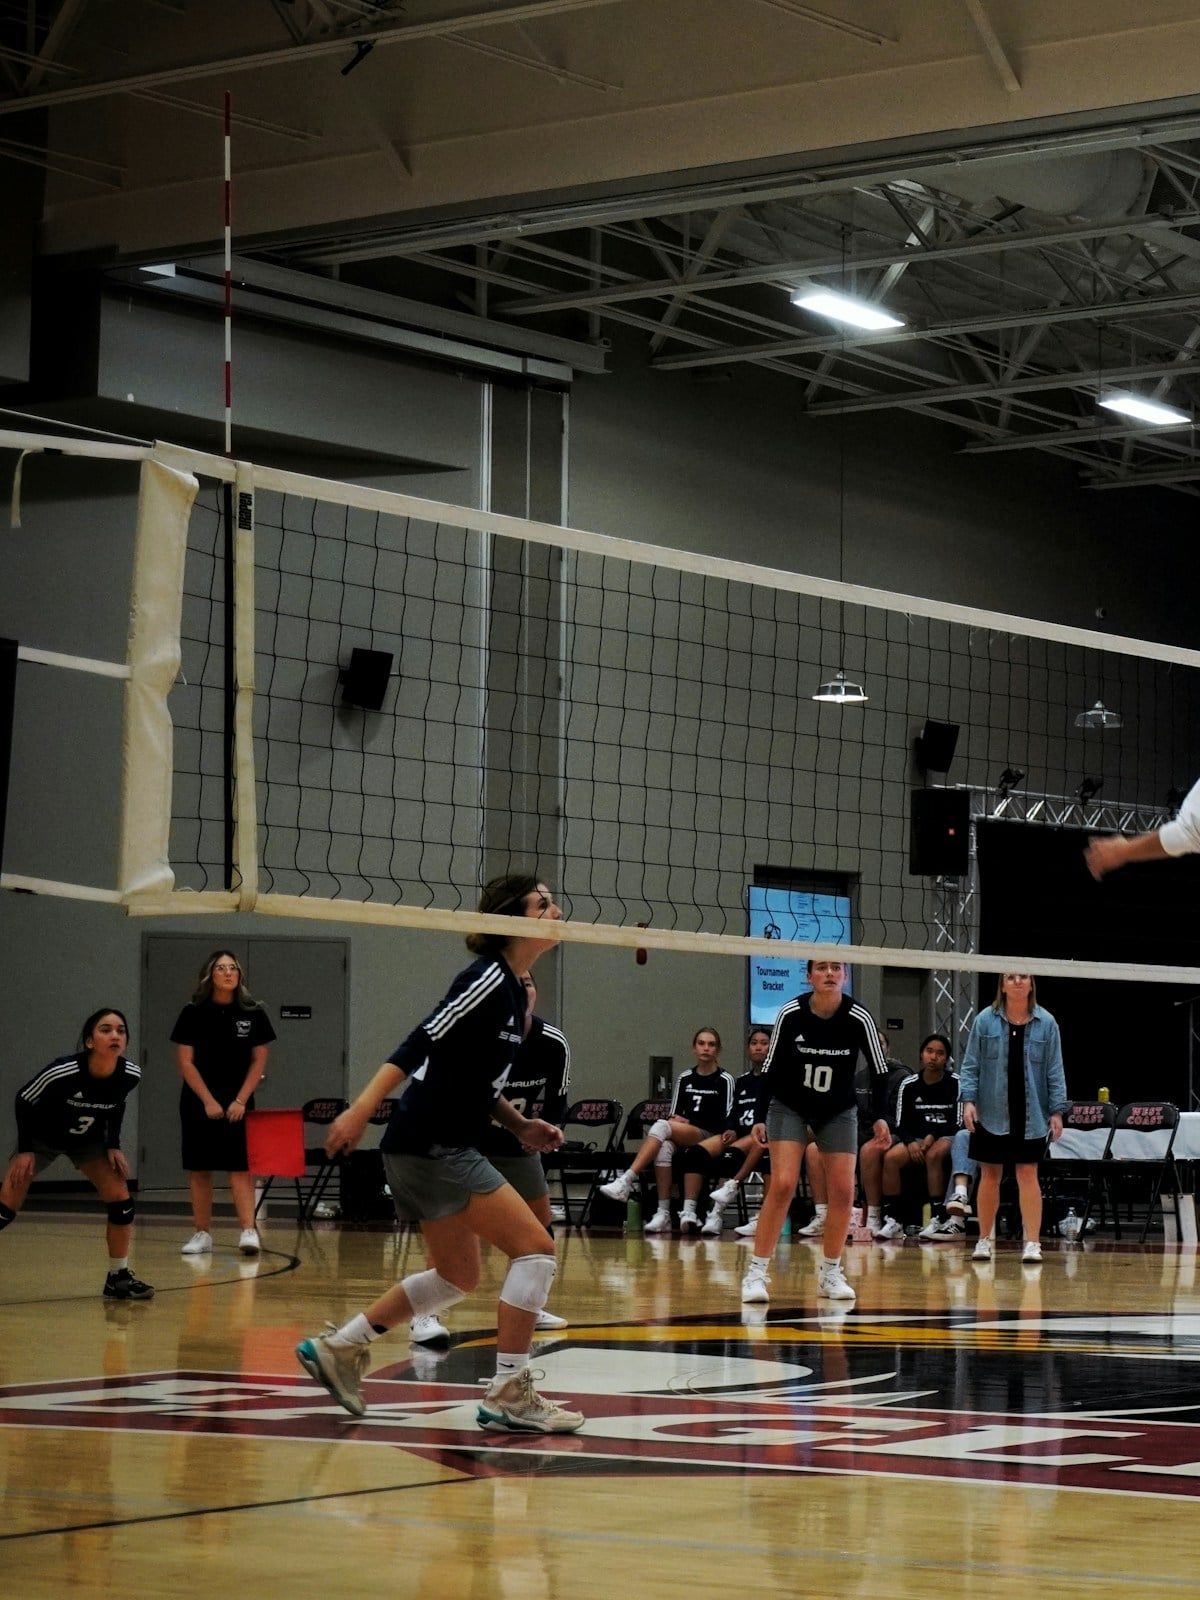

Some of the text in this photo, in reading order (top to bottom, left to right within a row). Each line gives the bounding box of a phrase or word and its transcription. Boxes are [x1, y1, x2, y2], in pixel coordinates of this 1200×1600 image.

[756, 966, 790, 978] Tournament
[762, 980, 785, 991] Bracket
[803, 1063, 834, 1093] 10
[581, 1103, 609, 1111] WEST
[692, 1095, 703, 1112] 7
[577, 1110, 609, 1120] COAST
[1072, 1106, 1104, 1115] WEST
[1131, 1106, 1163, 1116] WEST
[1068, 1114, 1104, 1124] COAST
[1126, 1115, 1164, 1125] COAST
[69, 1116, 95, 1134] 3
